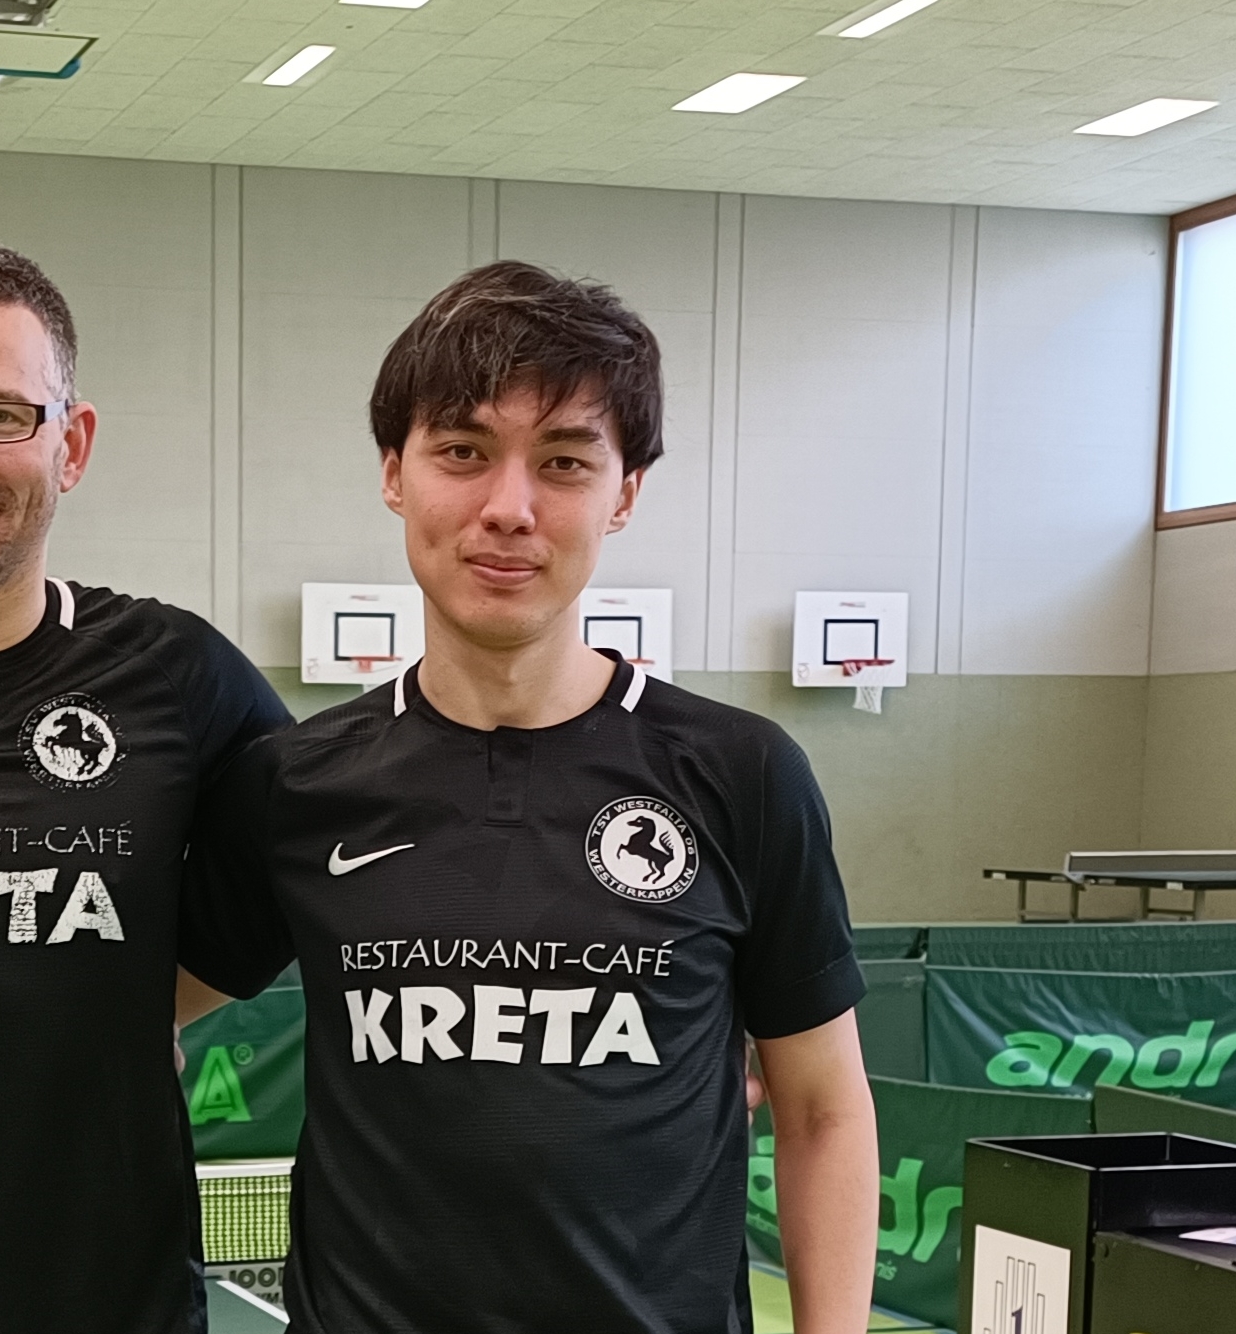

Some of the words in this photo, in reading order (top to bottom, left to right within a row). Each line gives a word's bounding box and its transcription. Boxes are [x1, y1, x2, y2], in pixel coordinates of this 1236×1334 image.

[592, 811, 611, 838] TSV
[613, 801, 687, 833] WESTFALIA
[589, 849, 694, 899] WESTERKAPPELN
[341, 939, 675, 976] RESTAURANT-CAFÉ
[345, 985, 661, 1066] KRETA
